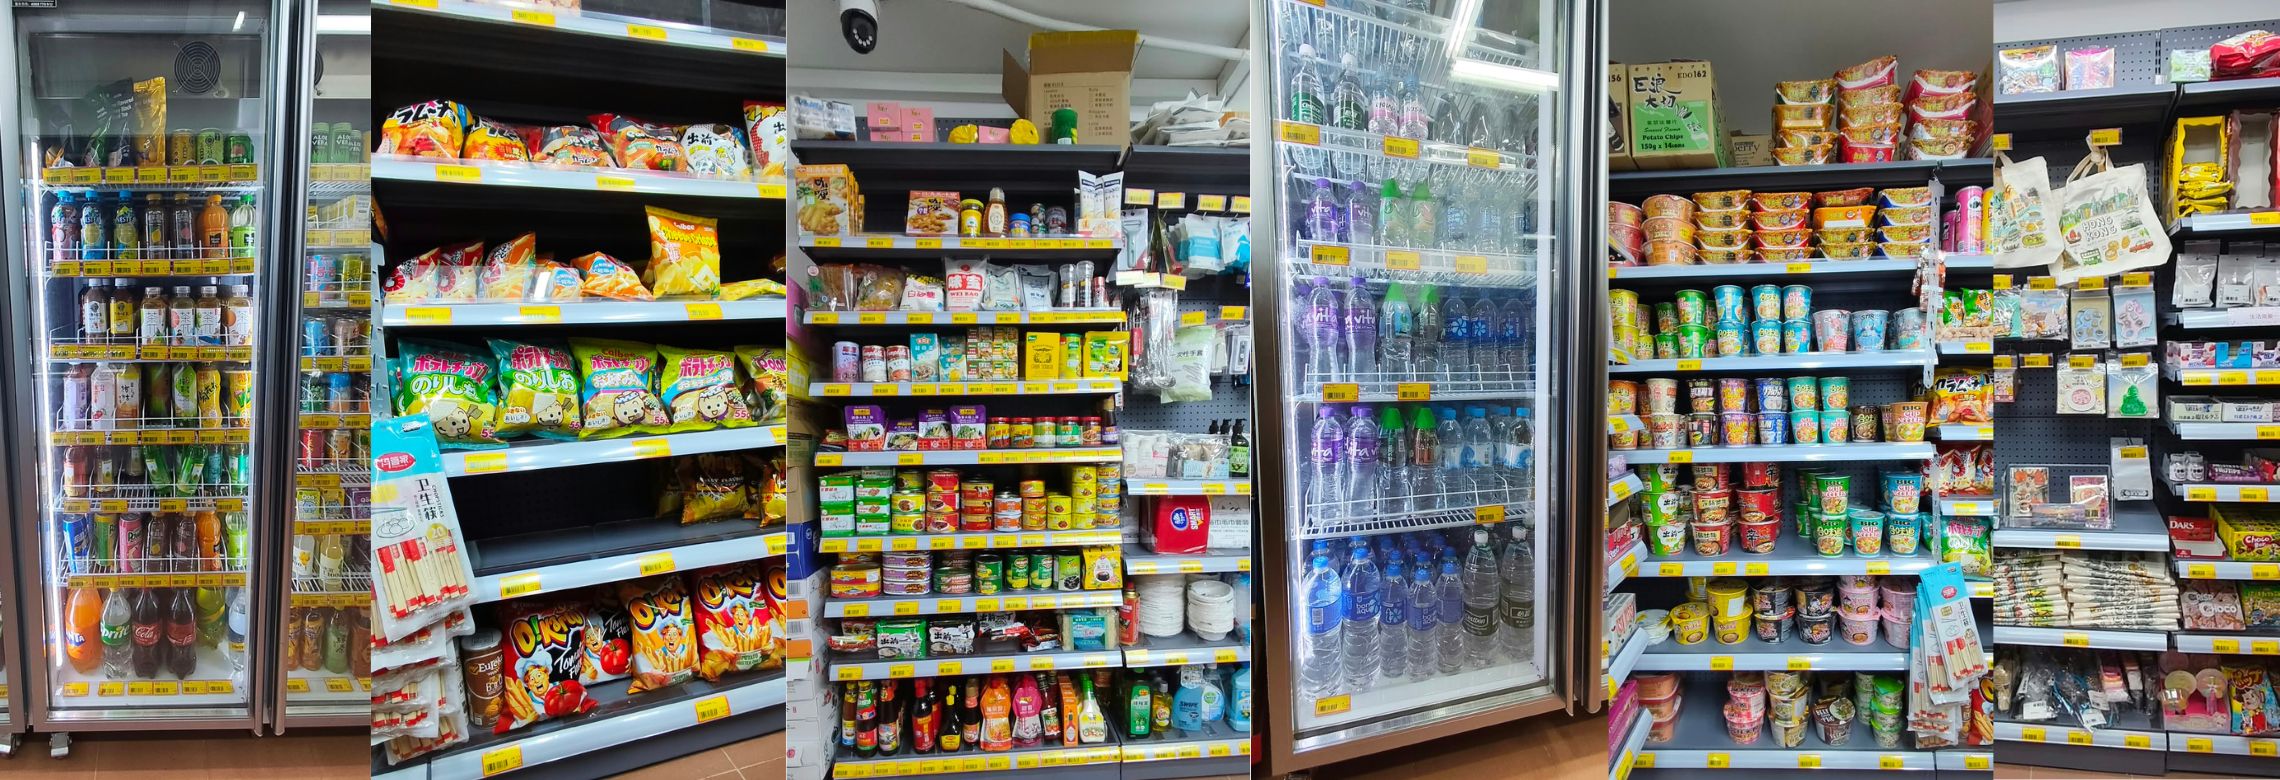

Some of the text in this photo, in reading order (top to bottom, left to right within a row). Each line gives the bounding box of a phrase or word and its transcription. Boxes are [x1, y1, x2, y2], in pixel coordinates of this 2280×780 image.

[1693, 69, 1707, 78] 162
[1645, 95, 1677, 108] 大切
[2082, 215, 2115, 233] HONG
[2086, 227, 2119, 241] KONG
[2169, 520, 2194, 530] DARS
[1747, 529, 1759, 552] 辛
[2245, 536, 2270, 544] Choco
